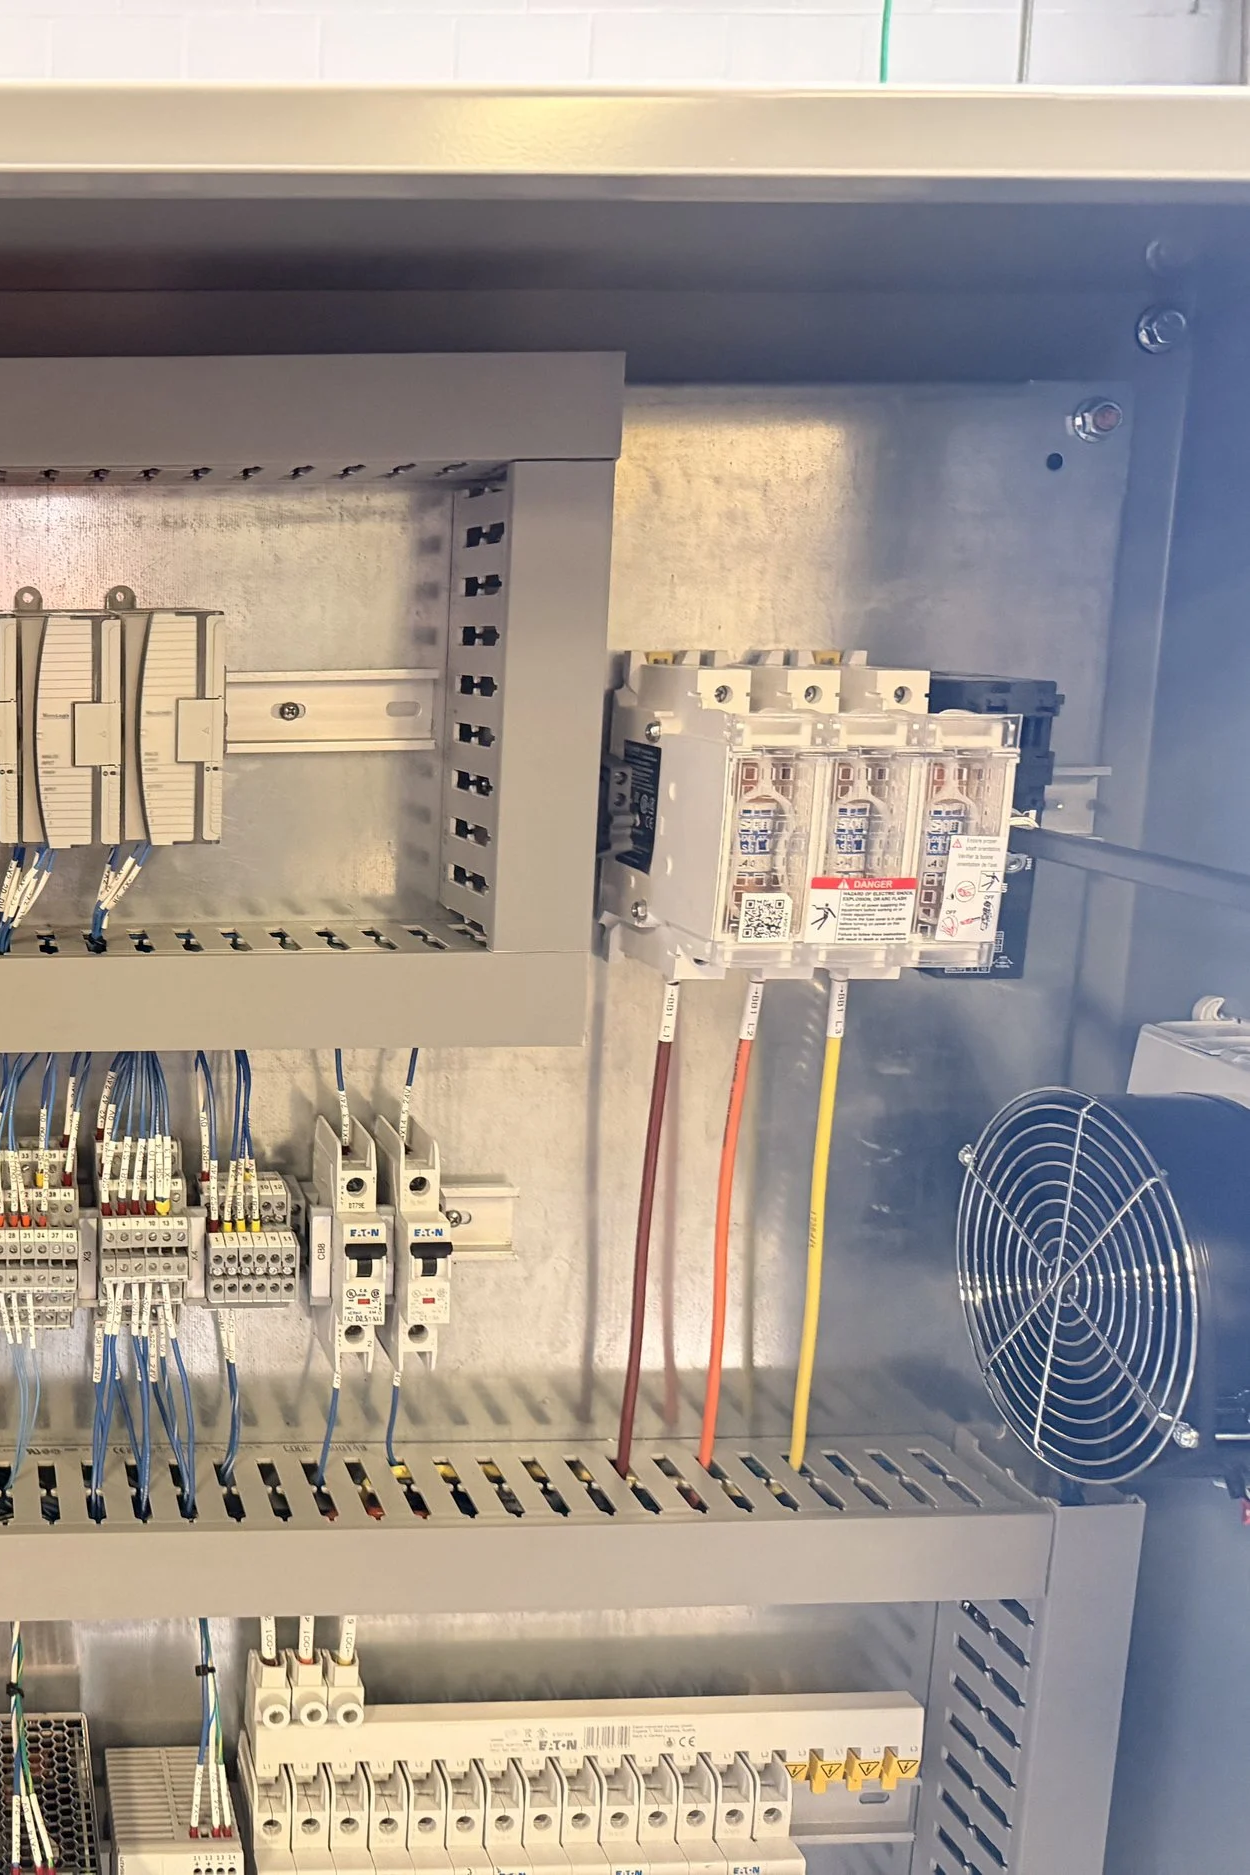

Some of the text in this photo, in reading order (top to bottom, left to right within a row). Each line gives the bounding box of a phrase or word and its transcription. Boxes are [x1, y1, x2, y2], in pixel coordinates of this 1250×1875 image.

[853, 880, 893, 889] DANGER
[747, 1023, 755, 1037] L2
[835, 1021, 843, 1035] L3
[350, 1229, 380, 1237] EATON
[413, 1228, 443, 1237] EATON
[83, 1251, 92, 1262] X3
[191, 1250, 199, 1262] X4
[317, 1243, 326, 1261] CB8
[538, 1740, 577, 1751] EATON
